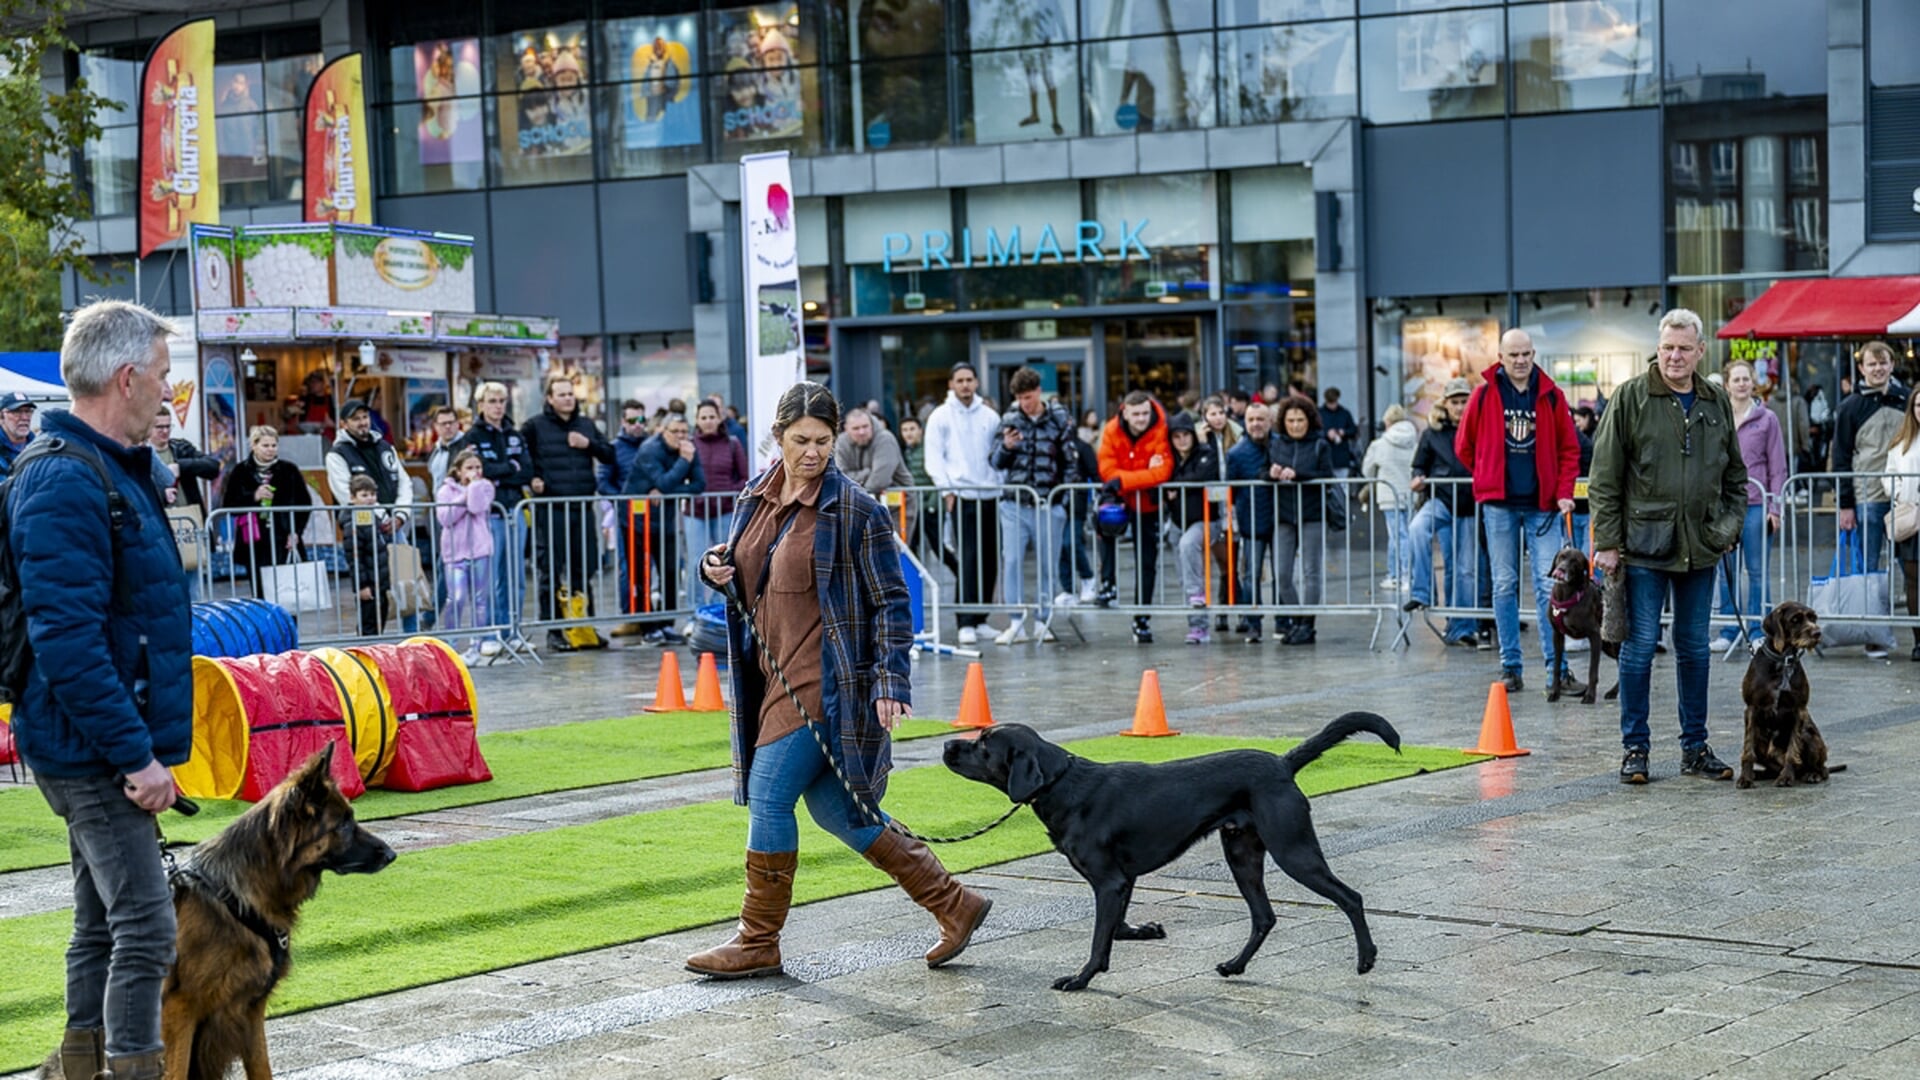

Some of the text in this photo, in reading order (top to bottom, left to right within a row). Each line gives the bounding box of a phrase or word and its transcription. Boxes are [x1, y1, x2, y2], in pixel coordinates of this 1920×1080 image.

[172, 85, 199, 195] Churreria
[333, 115, 356, 210] Churreria
[883, 219, 1151, 273] PRIMARK
